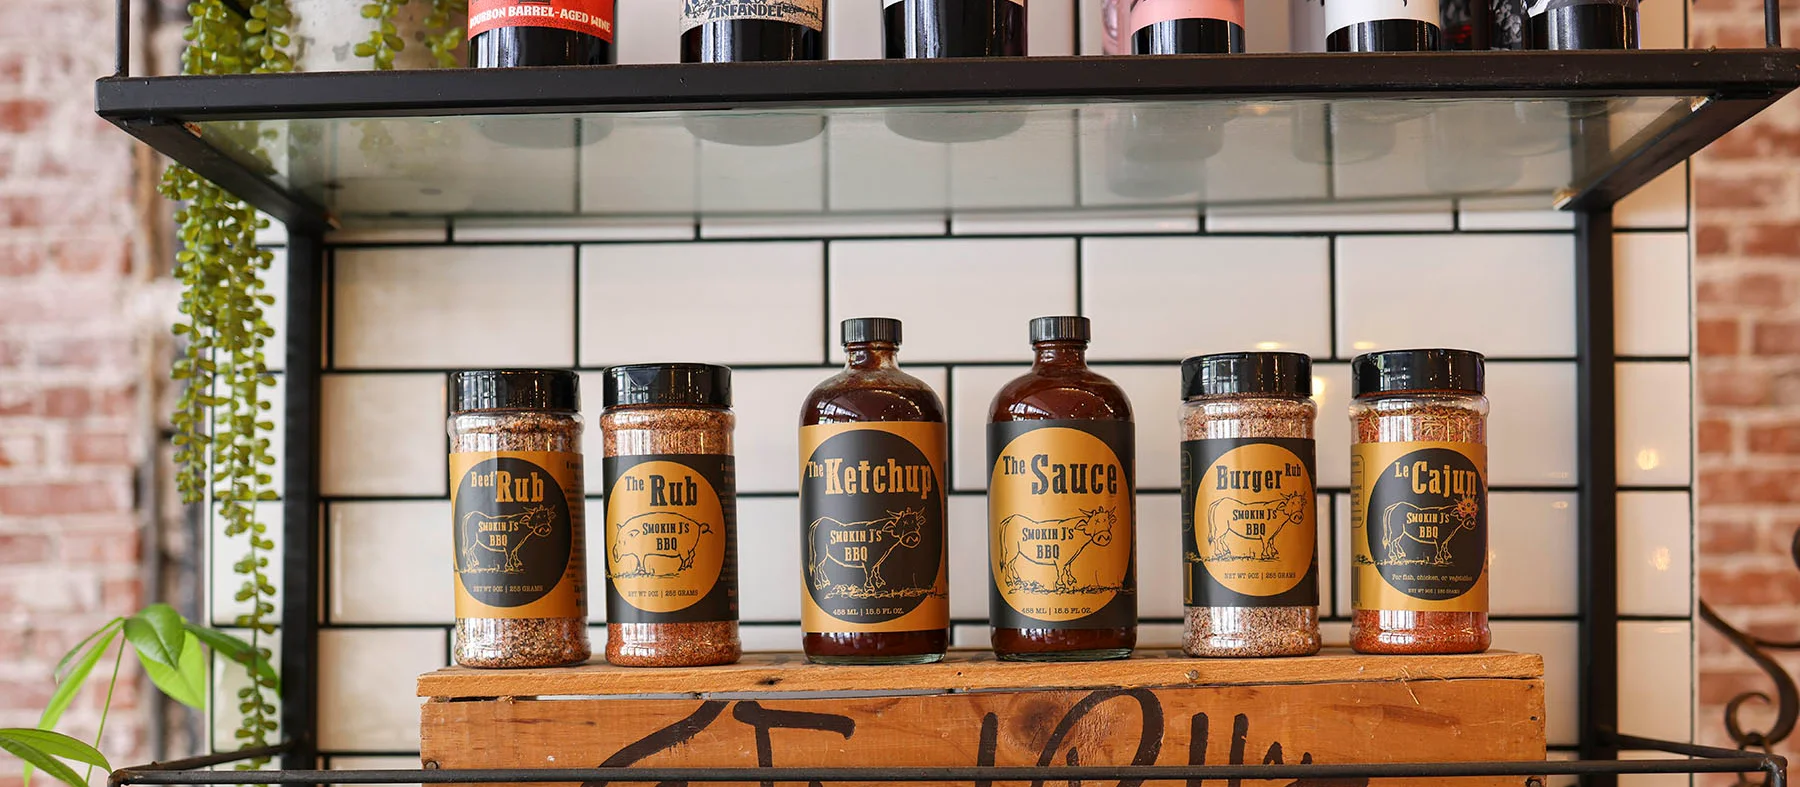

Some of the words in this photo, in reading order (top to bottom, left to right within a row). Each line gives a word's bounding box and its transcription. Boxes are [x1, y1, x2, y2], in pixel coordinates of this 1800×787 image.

[708, 4, 784, 19] ZINFANDEL
[470, 7, 506, 29] BOURBON
[508, 6, 589, 23] BARREL-AGED
[590, 15, 611, 33] WINE
[808, 461, 824, 478] The
[824, 458, 932, 499] Ketchup
[1003, 456, 1025, 475] The
[1031, 454, 1117, 495] Sauce
[1216, 464, 1282, 493] Burger
[1285, 463, 1301, 477] Rub
[1394, 461, 1409, 478] Le
[1411, 460, 1477, 498] Cajun
[471, 471, 494, 487] Beef
[495, 470, 545, 503] Rub
[625, 476, 644, 491] The
[649, 474, 698, 507] Rub
[1232, 509, 1265, 521] SMOKIN
[1406, 511, 1438, 524] SMOKIN
[478, 521, 507, 532] SMOKIN
[642, 522, 676, 536] SMOKIN
[1246, 523, 1266, 536] BBQ
[1419, 526, 1438, 538] BBQ
[489, 534, 508, 547] BBQ
[830, 529, 866, 545] SMOKIN
[1022, 527, 1058, 542] SMOKIN
[656, 537, 678, 551] BBQ
[844, 546, 868, 562] BBQ
[1036, 544, 1060, 560] BBQ
